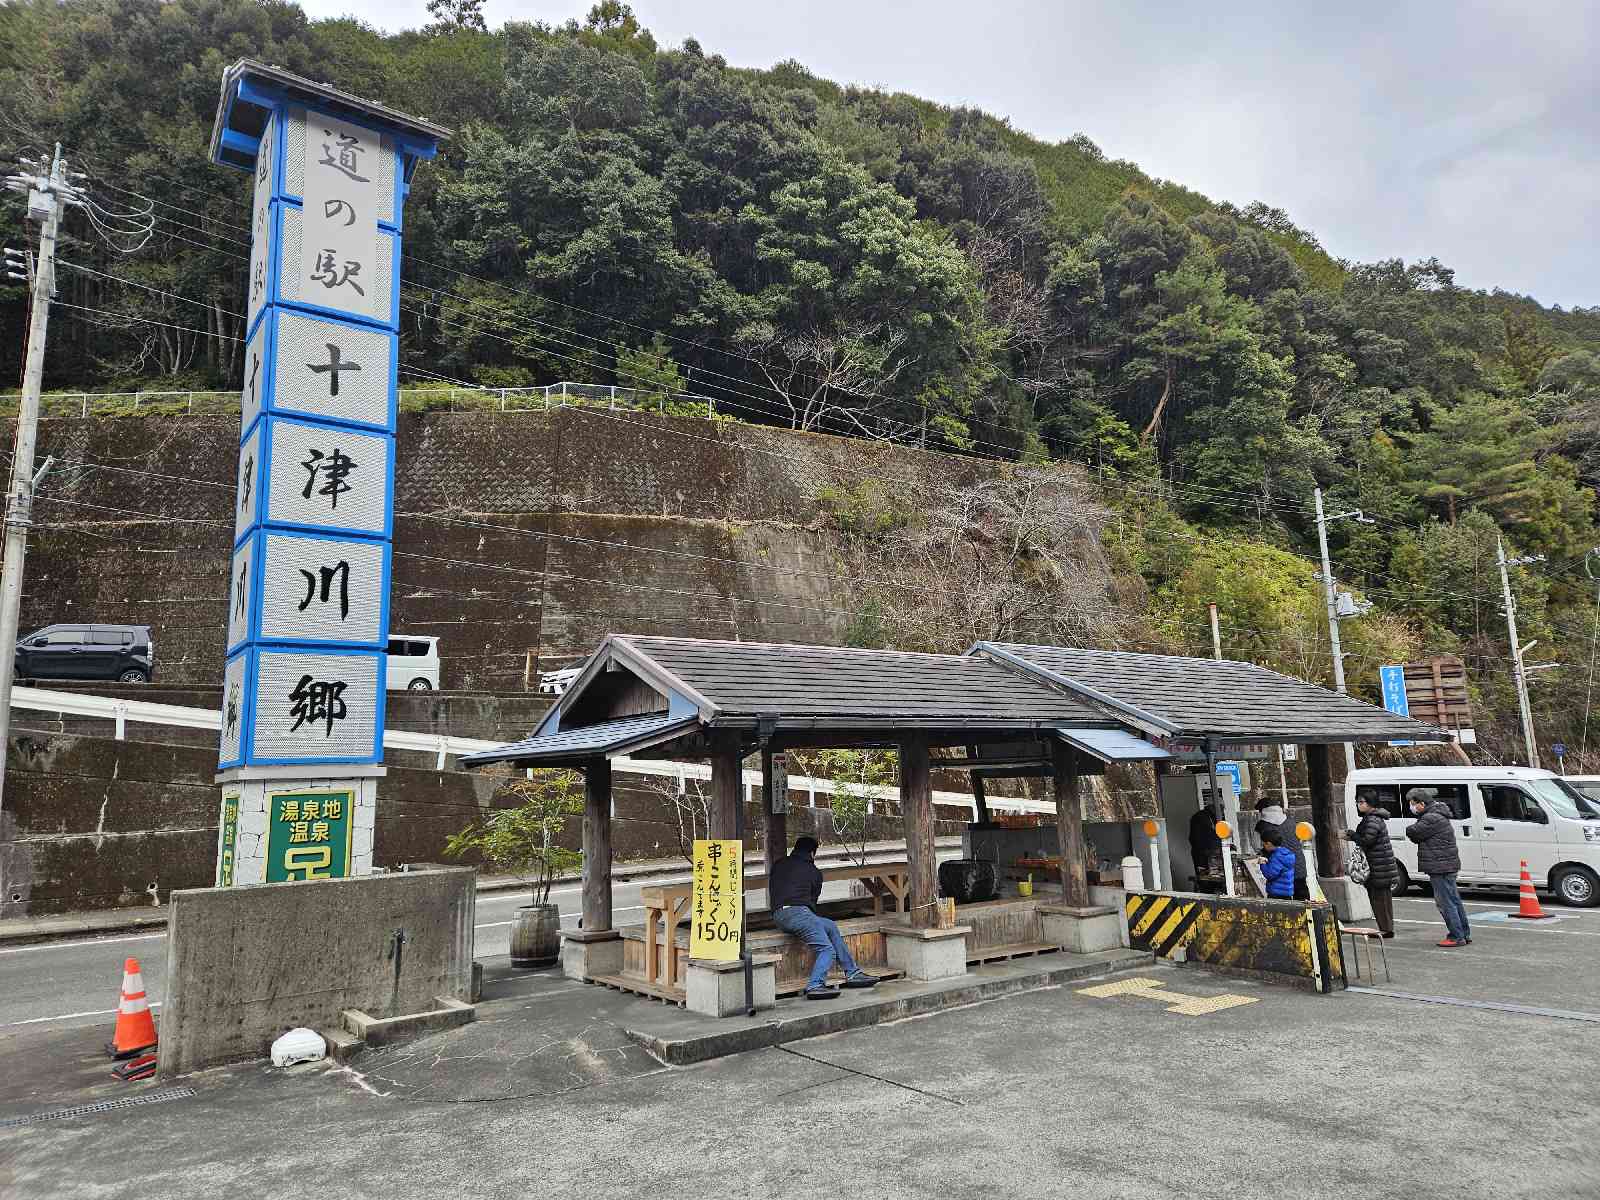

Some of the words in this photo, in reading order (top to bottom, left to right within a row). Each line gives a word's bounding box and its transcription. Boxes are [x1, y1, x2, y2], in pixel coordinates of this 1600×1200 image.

[310, 128, 371, 297] 道の駅
[289, 342, 363, 738] 十津川郷
[279, 800, 342, 822] 湯泉地
[289, 821, 329, 843] 温泉
[697, 921, 739, 943] 150円
